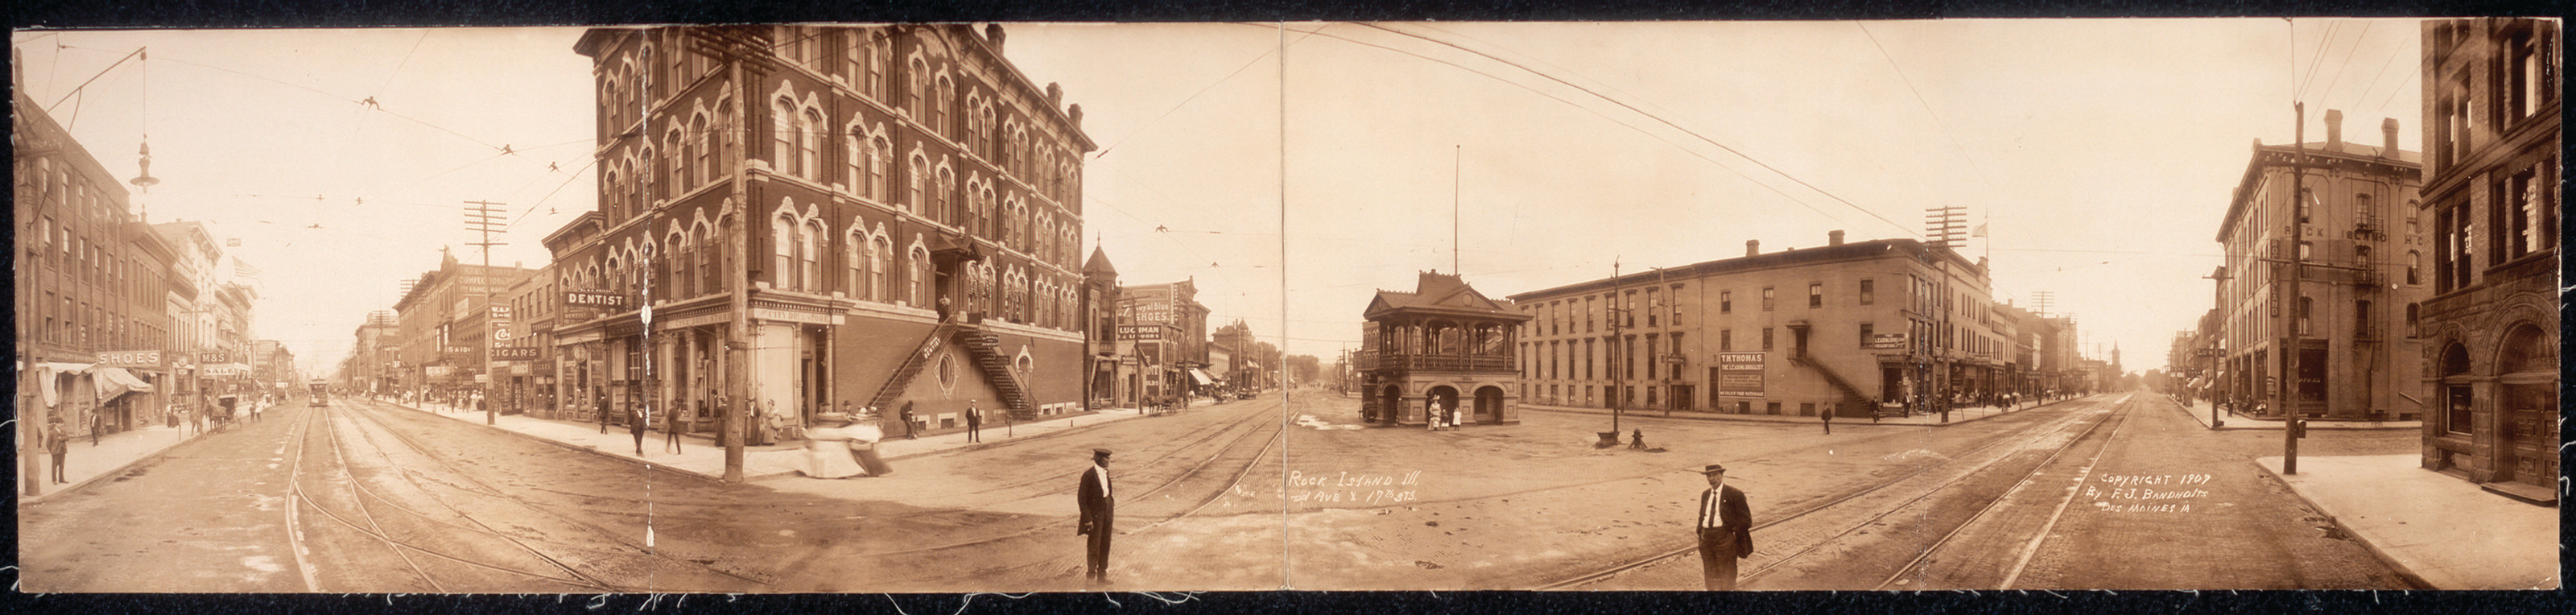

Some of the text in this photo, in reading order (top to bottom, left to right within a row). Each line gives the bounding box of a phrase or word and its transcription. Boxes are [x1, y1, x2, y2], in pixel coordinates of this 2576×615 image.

[2285, 225, 2323, 237] RCK
[459, 276, 515, 285] CONFECIONERY
[569, 293, 623, 306] DENTIST
[1154, 302, 1169, 311] Blue
[768, 311, 786, 319] CITY
[807, 314, 831, 323] STORE
[98, 353, 159, 365] SHOES
[202, 353, 225, 362] M&S
[1732, 354, 1762, 362] THOMAS
[204, 366, 235, 374] SALE
